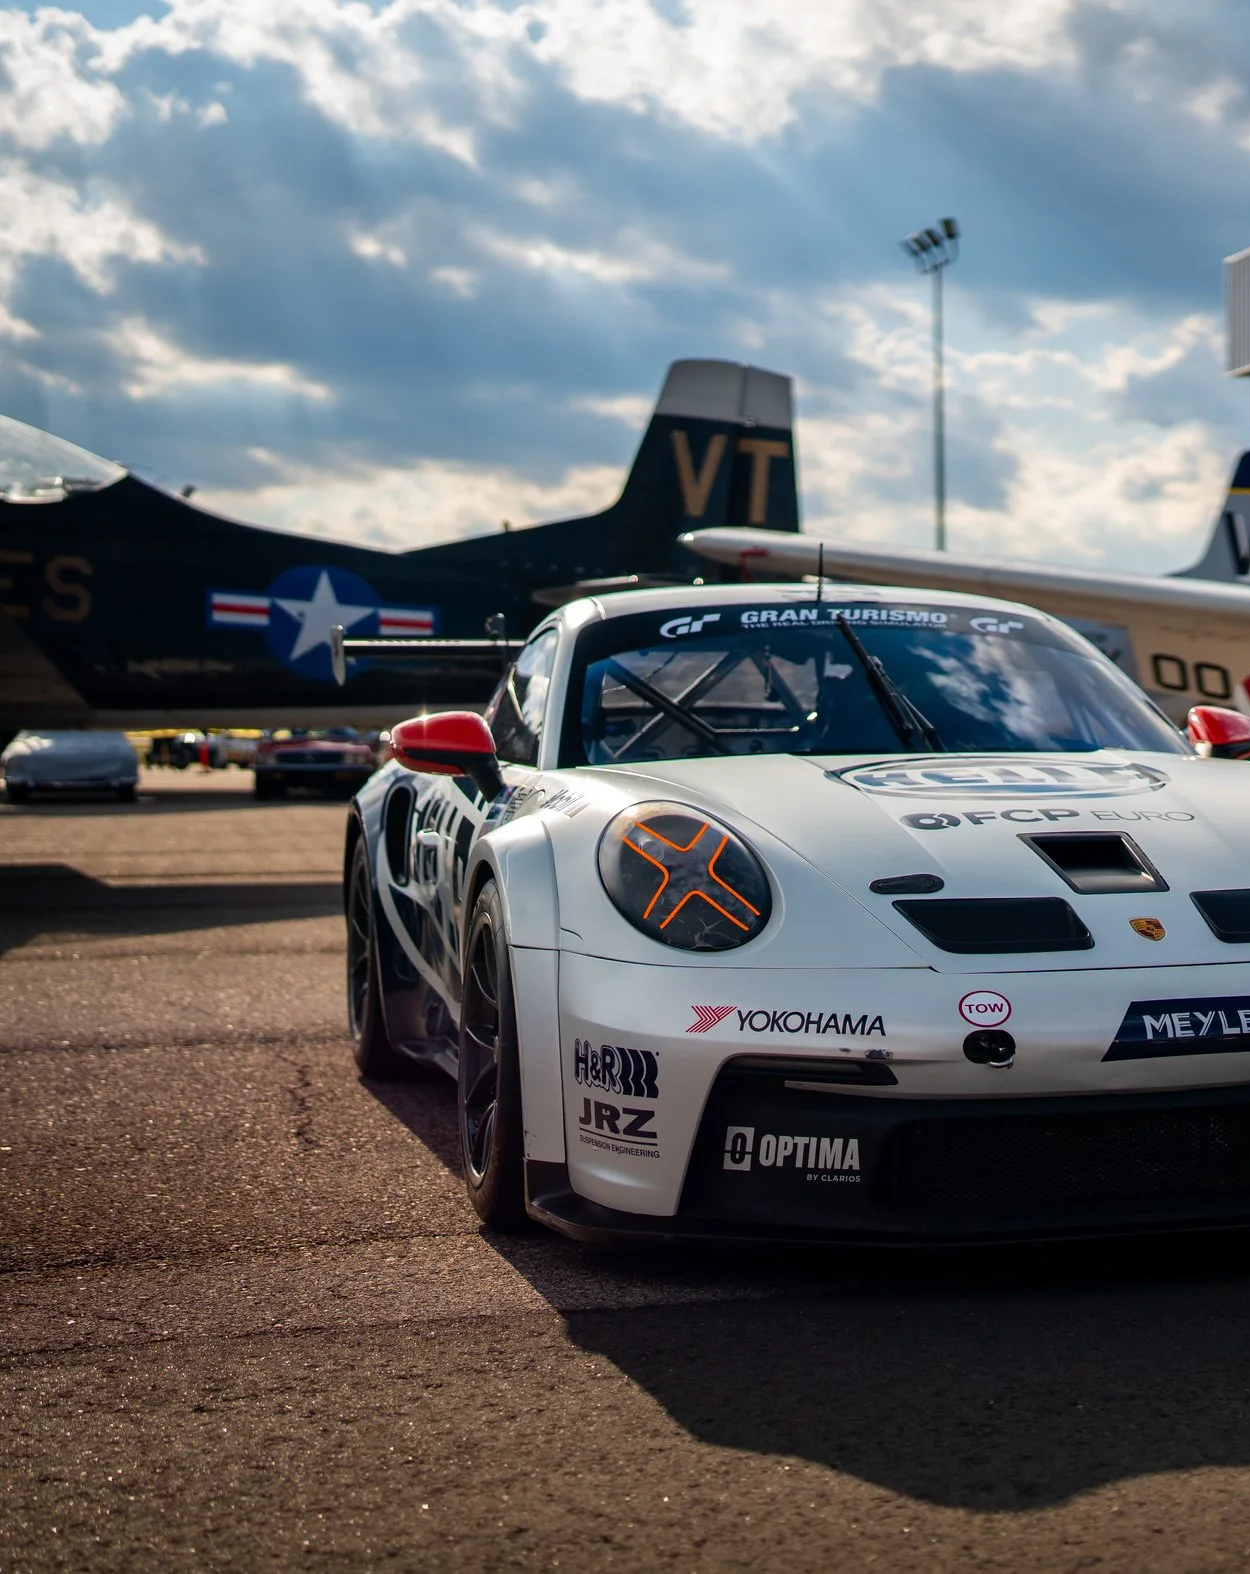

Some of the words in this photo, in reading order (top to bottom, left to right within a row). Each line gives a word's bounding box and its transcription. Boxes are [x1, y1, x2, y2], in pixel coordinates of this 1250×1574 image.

[670, 429, 789, 524] VT
[741, 609, 818, 624] GRAN
[828, 609, 948, 624] TURISMO
[742, 622, 769, 630] THE
[772, 620, 809, 628] REAL
[871, 620, 947, 629] SIMULATOR
[962, 809, 1080, 826] FCP
[1089, 810, 1196, 823] EURO
[965, 1002, 1004, 1015] TOW
[737, 1010, 887, 1037] YOKOHAMA
[575, 1038, 622, 1095] H&R
[579, 1097, 658, 1139] JRZ
[580, 1134, 611, 1151] SUSPENSION
[611, 1143, 660, 1158] ENGINEERING
[758, 1134, 861, 1171] OPTIMA
[806, 1174, 818, 1182] BY
[821, 1174, 861, 1183] CLARIOS
